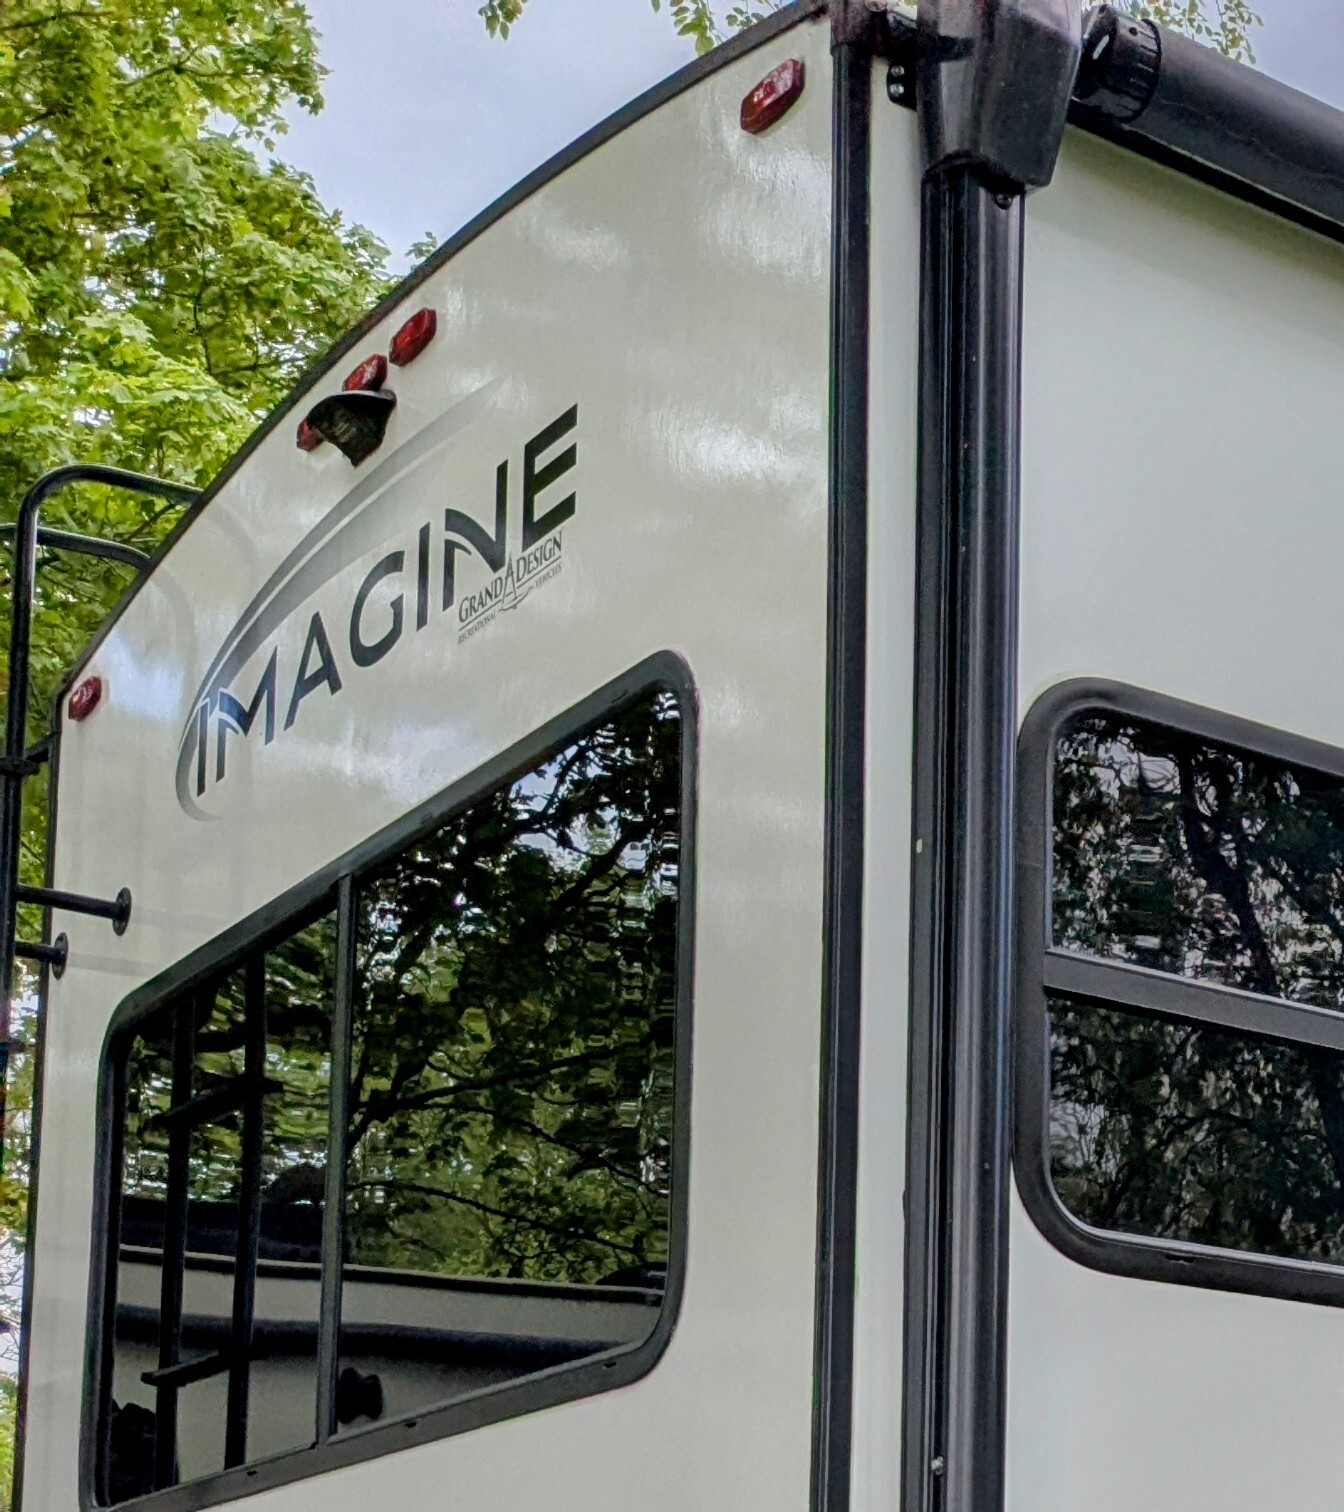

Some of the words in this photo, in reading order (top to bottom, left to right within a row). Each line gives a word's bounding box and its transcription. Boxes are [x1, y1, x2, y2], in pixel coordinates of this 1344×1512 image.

[197, 403, 578, 797] IMAGINE
[459, 576, 504, 623] GRAND
[516, 530, 562, 583] DESIGN
